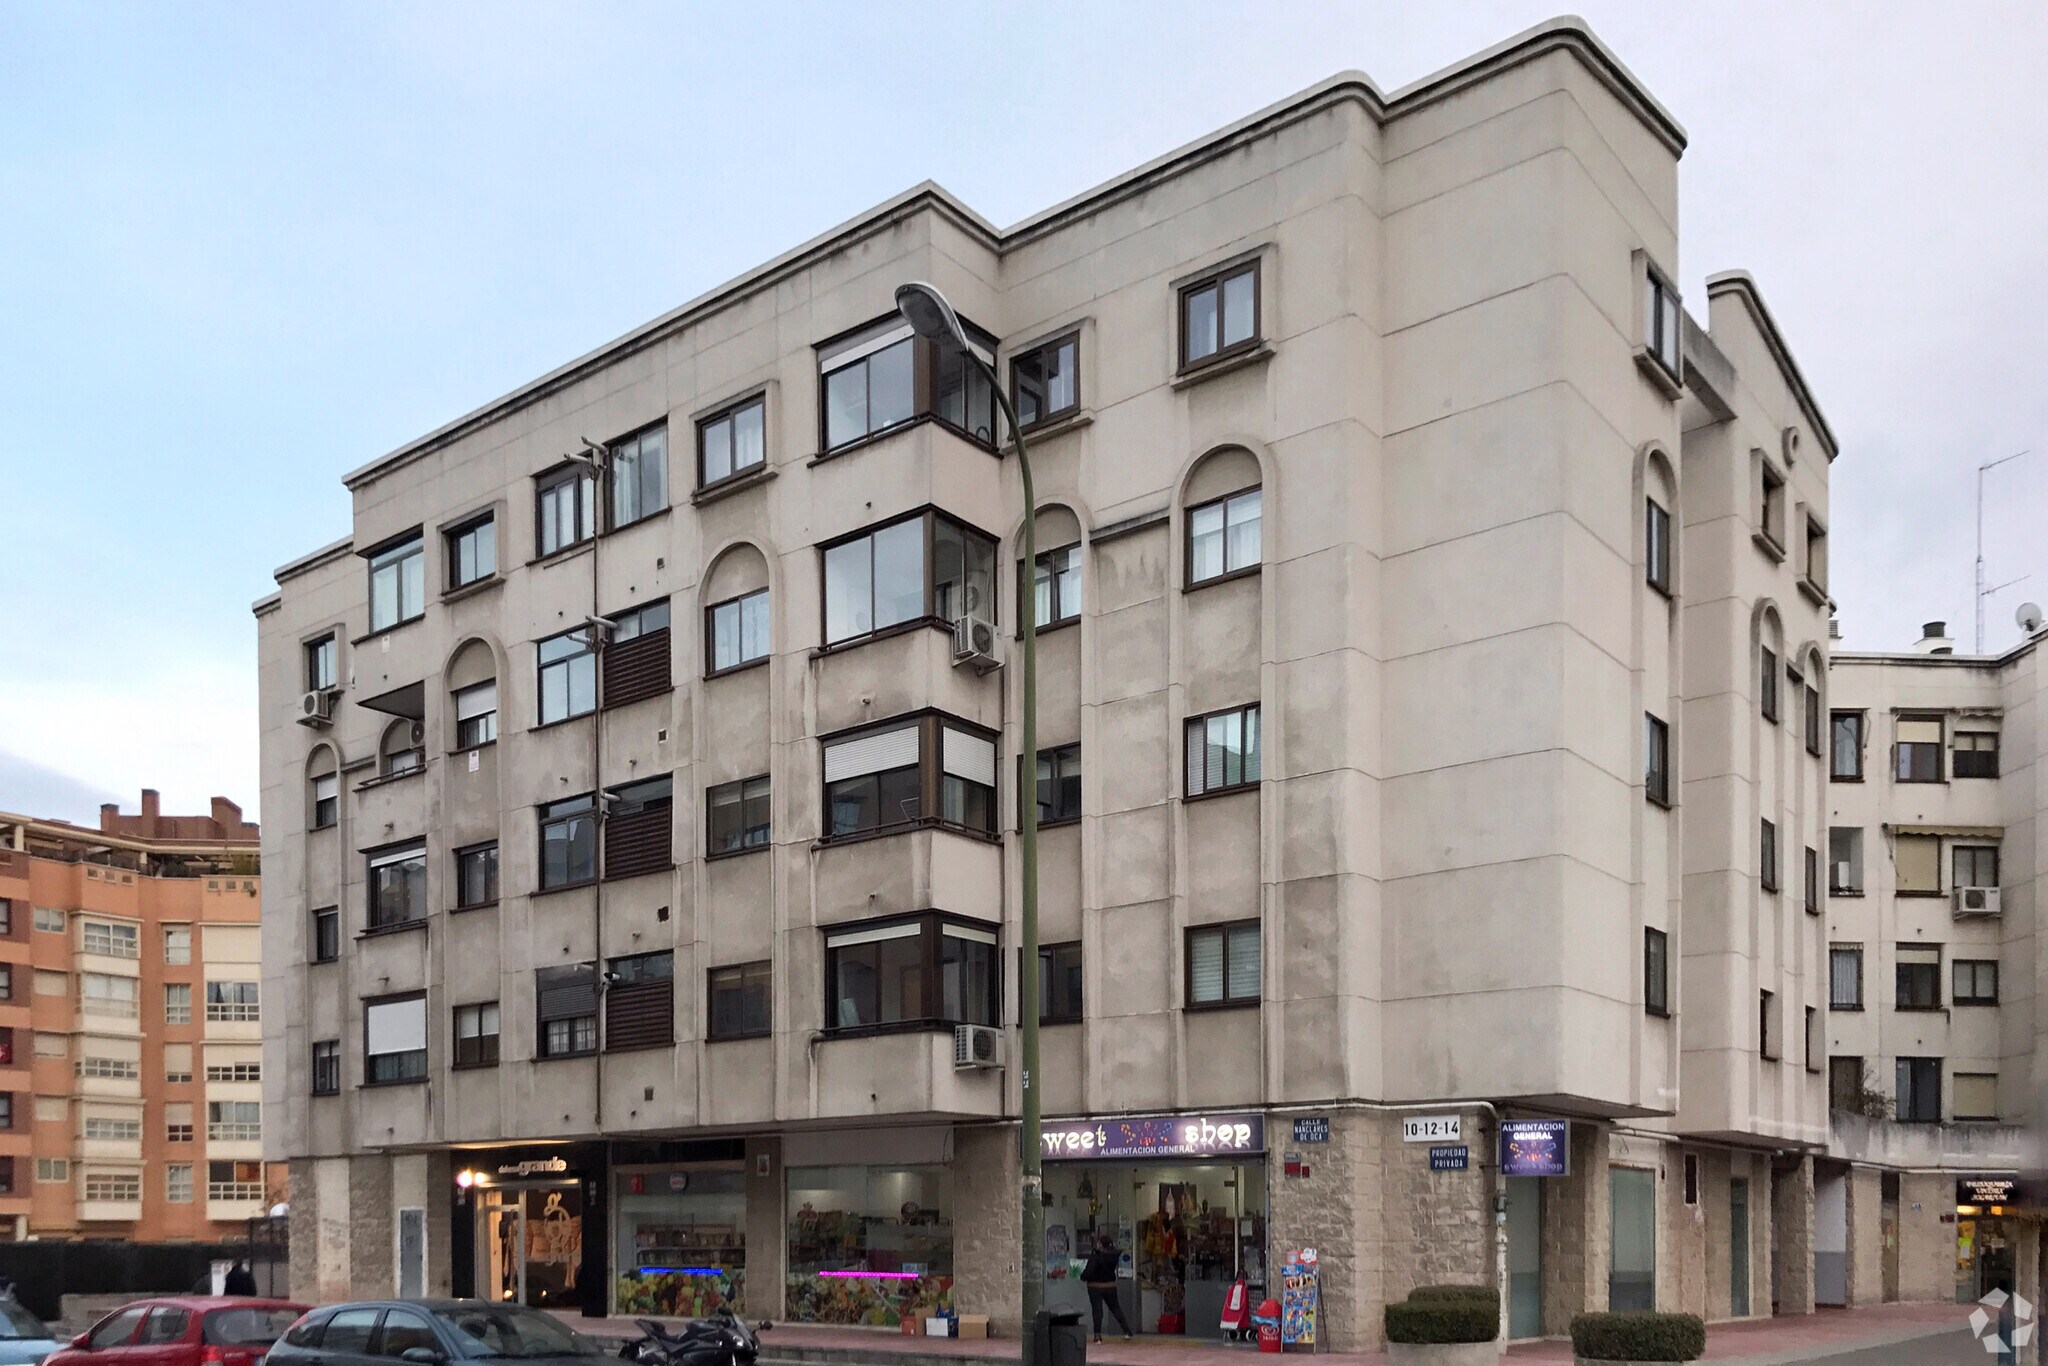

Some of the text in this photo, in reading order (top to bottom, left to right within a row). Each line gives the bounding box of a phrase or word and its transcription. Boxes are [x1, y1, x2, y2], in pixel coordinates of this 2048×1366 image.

[1294, 1124, 1328, 1134] NANCLARES
[1405, 1121, 1459, 1136] 10-12-14
[1502, 1122, 1565, 1132] ALIMENTACION
[1040, 1118, 1251, 1150] weet shop
[1300, 1132, 1323, 1141] DE OCA
[1513, 1131, 1553, 1141] GENERAL
[1100, 1144, 1196, 1156] ALIMENTACION GENERAL
[1431, 1148, 1467, 1158] PROPIEDAD
[1434, 1159, 1464, 1168] PRIVADA
